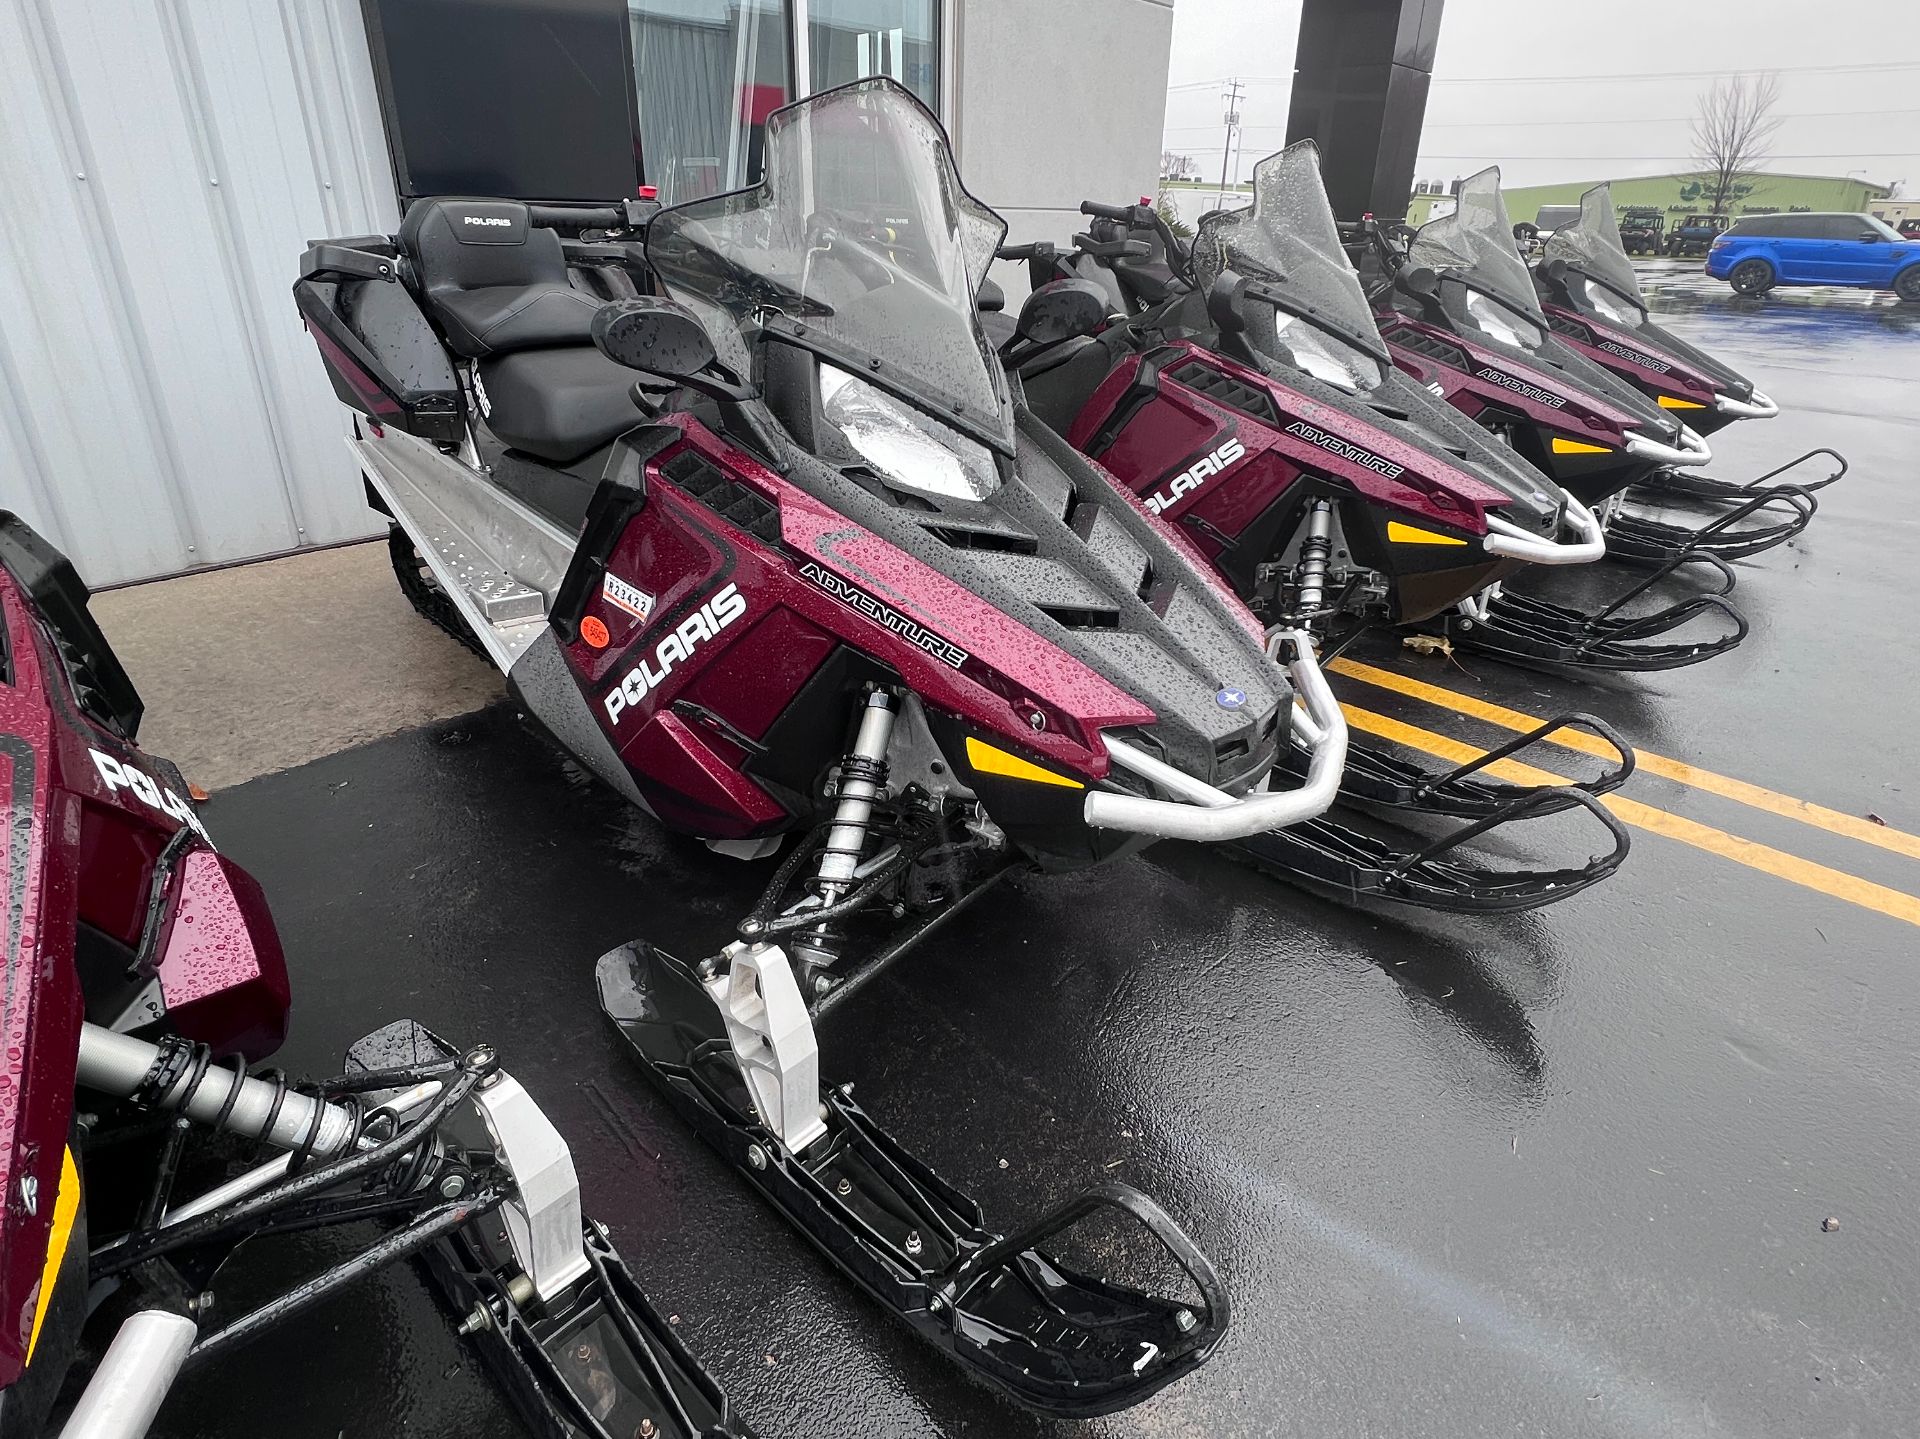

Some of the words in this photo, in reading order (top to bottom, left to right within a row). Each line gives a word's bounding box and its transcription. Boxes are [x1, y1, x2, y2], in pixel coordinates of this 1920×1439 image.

[464, 216, 512, 227] POLARIS
[1598, 341, 1672, 374] ADVENTURE
[471, 357, 492, 419] OLARIS
[1476, 368, 1567, 409] ADVENTURE
[1144, 438, 1246, 516] LARIS
[1284, 421, 1404, 480] ADVENTURE
[608, 581, 647, 613] R23422
[799, 562, 968, 669] ADVENTURE
[604, 582, 747, 725] POLARIS
[88, 747, 219, 853] POLAR
